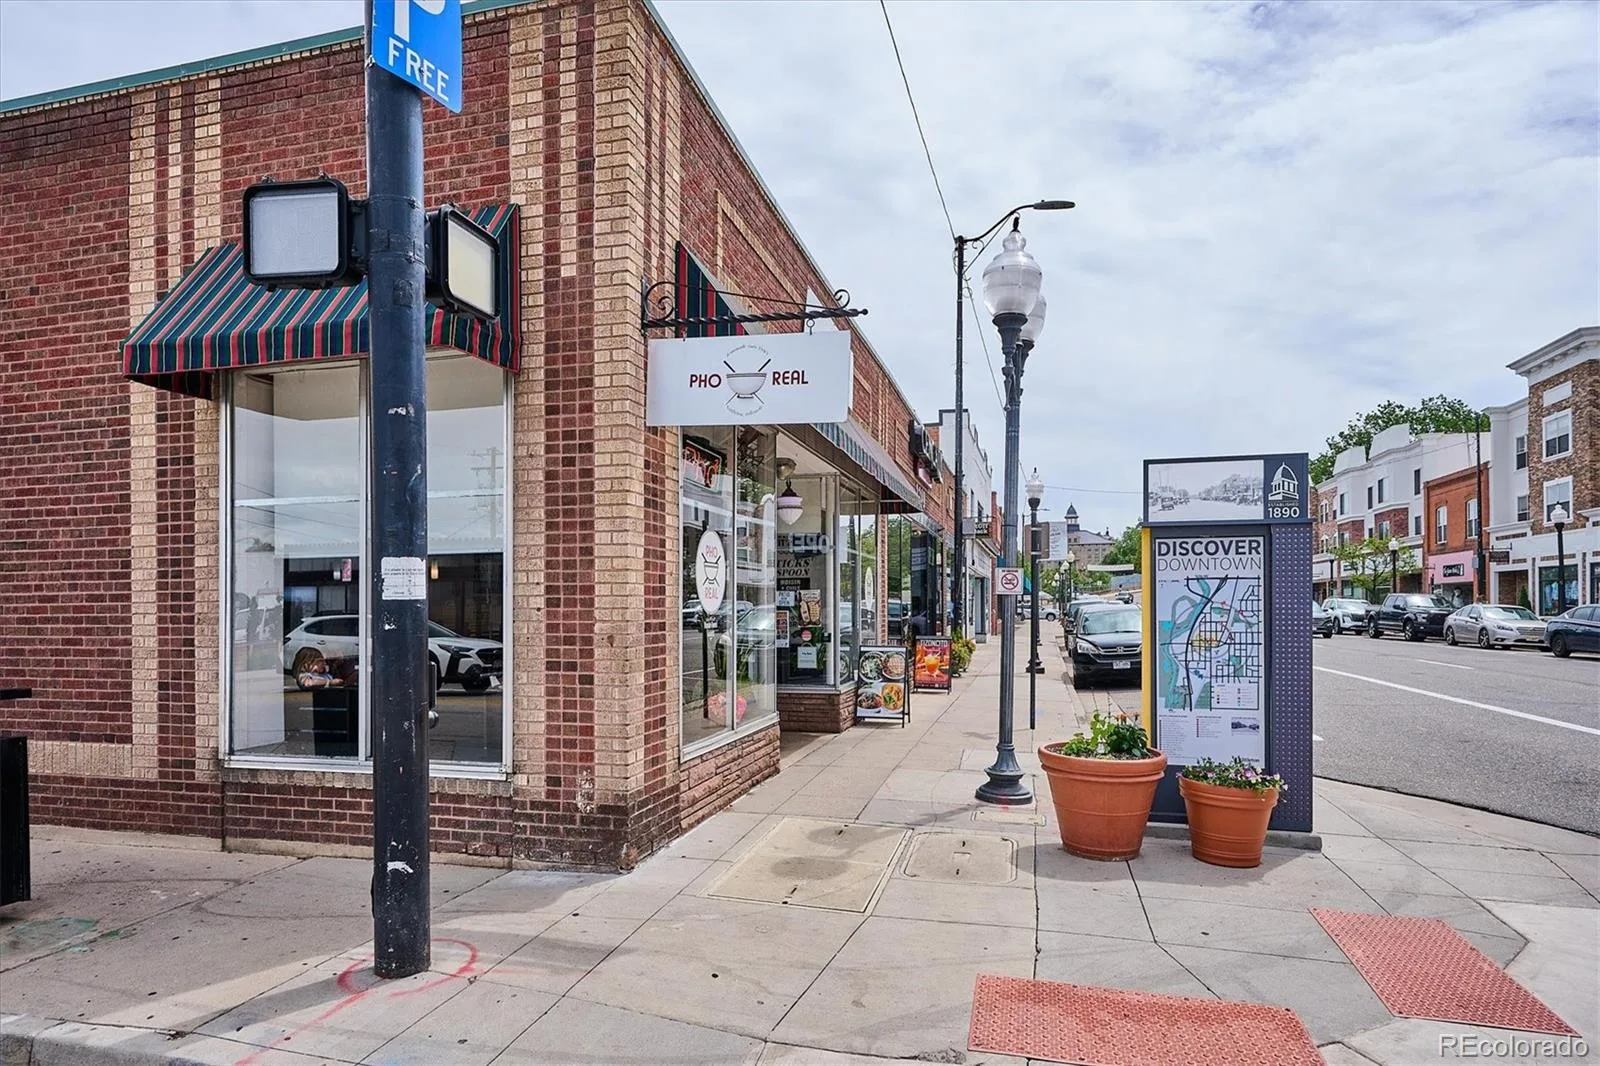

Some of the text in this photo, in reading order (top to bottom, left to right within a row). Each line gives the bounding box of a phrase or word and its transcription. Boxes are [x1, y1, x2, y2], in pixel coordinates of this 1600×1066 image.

[388, 36, 449, 102] FREE
[689, 370, 808, 388] PHO REAL
[1268, 507, 1300, 518] 1890
[705, 544, 718, 558] PHO
[1157, 539, 1262, 557] DISCOVER
[1157, 557, 1262, 572] DOWNTOWN
[704, 587, 719, 600] REAL
